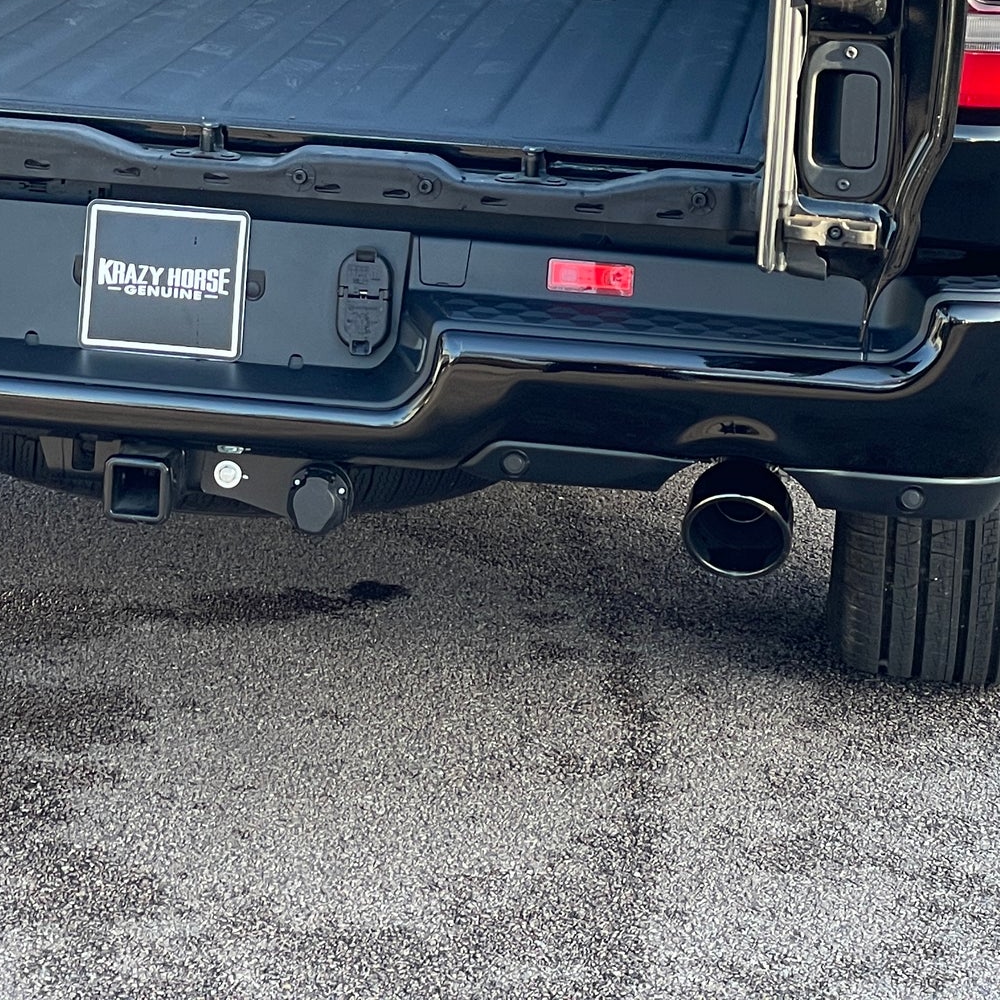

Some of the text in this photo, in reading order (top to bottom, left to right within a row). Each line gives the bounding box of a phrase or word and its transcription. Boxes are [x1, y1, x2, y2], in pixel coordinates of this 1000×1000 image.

[97, 257, 231, 296] KRAZY HORSE
[123, 285, 203, 300] GENUINE
